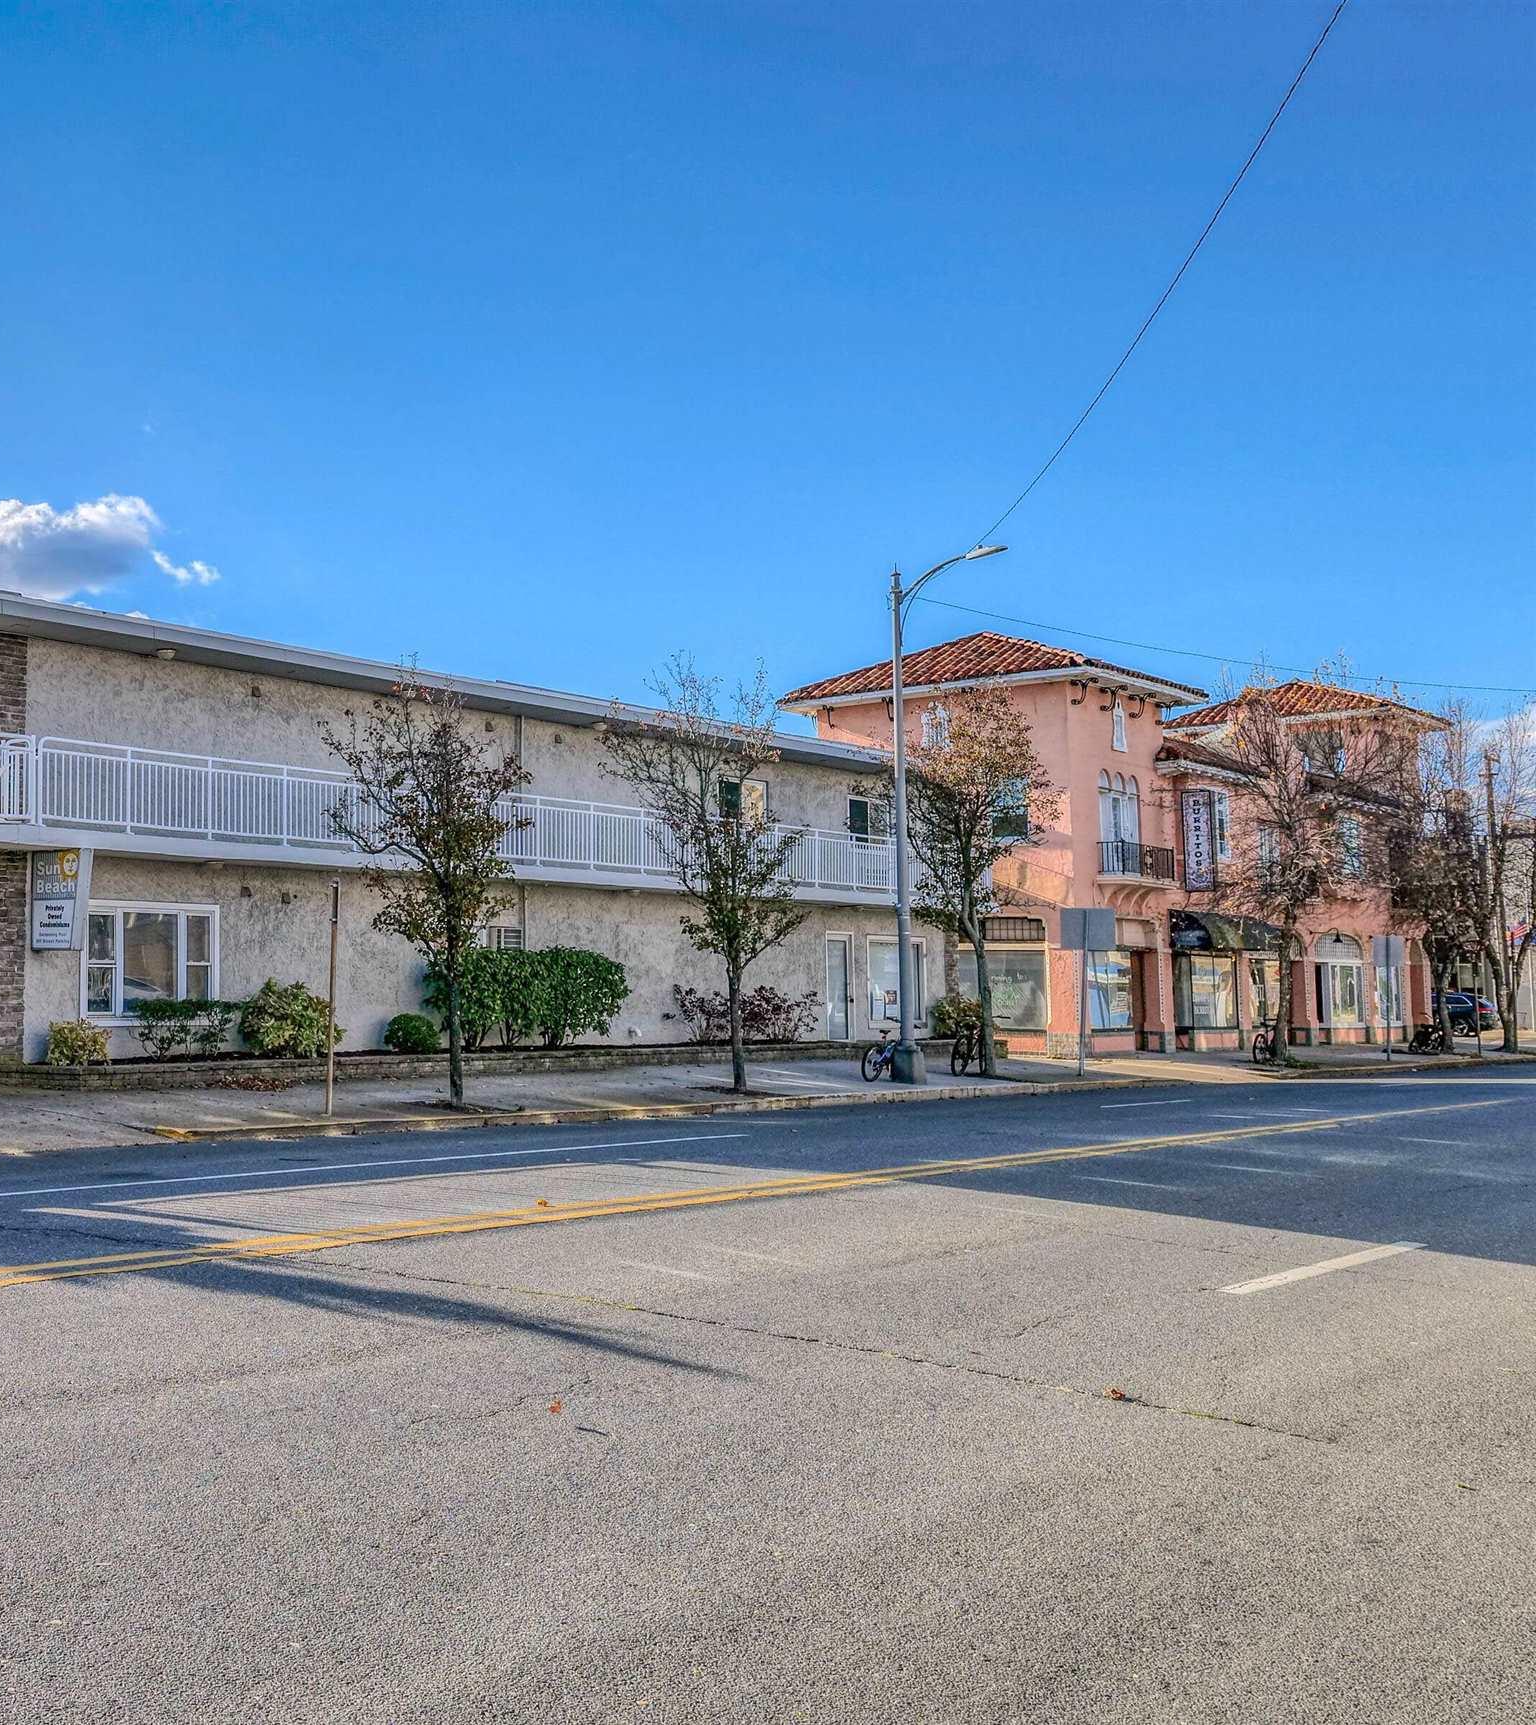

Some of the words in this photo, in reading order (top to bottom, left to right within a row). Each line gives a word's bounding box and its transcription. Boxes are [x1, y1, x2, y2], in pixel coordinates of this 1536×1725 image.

[1192, 799, 1203, 867] BURRITOS
[36, 861, 60, 876] Sun
[36, 880, 75, 894] Beach
[45, 904, 65, 912] Privately
